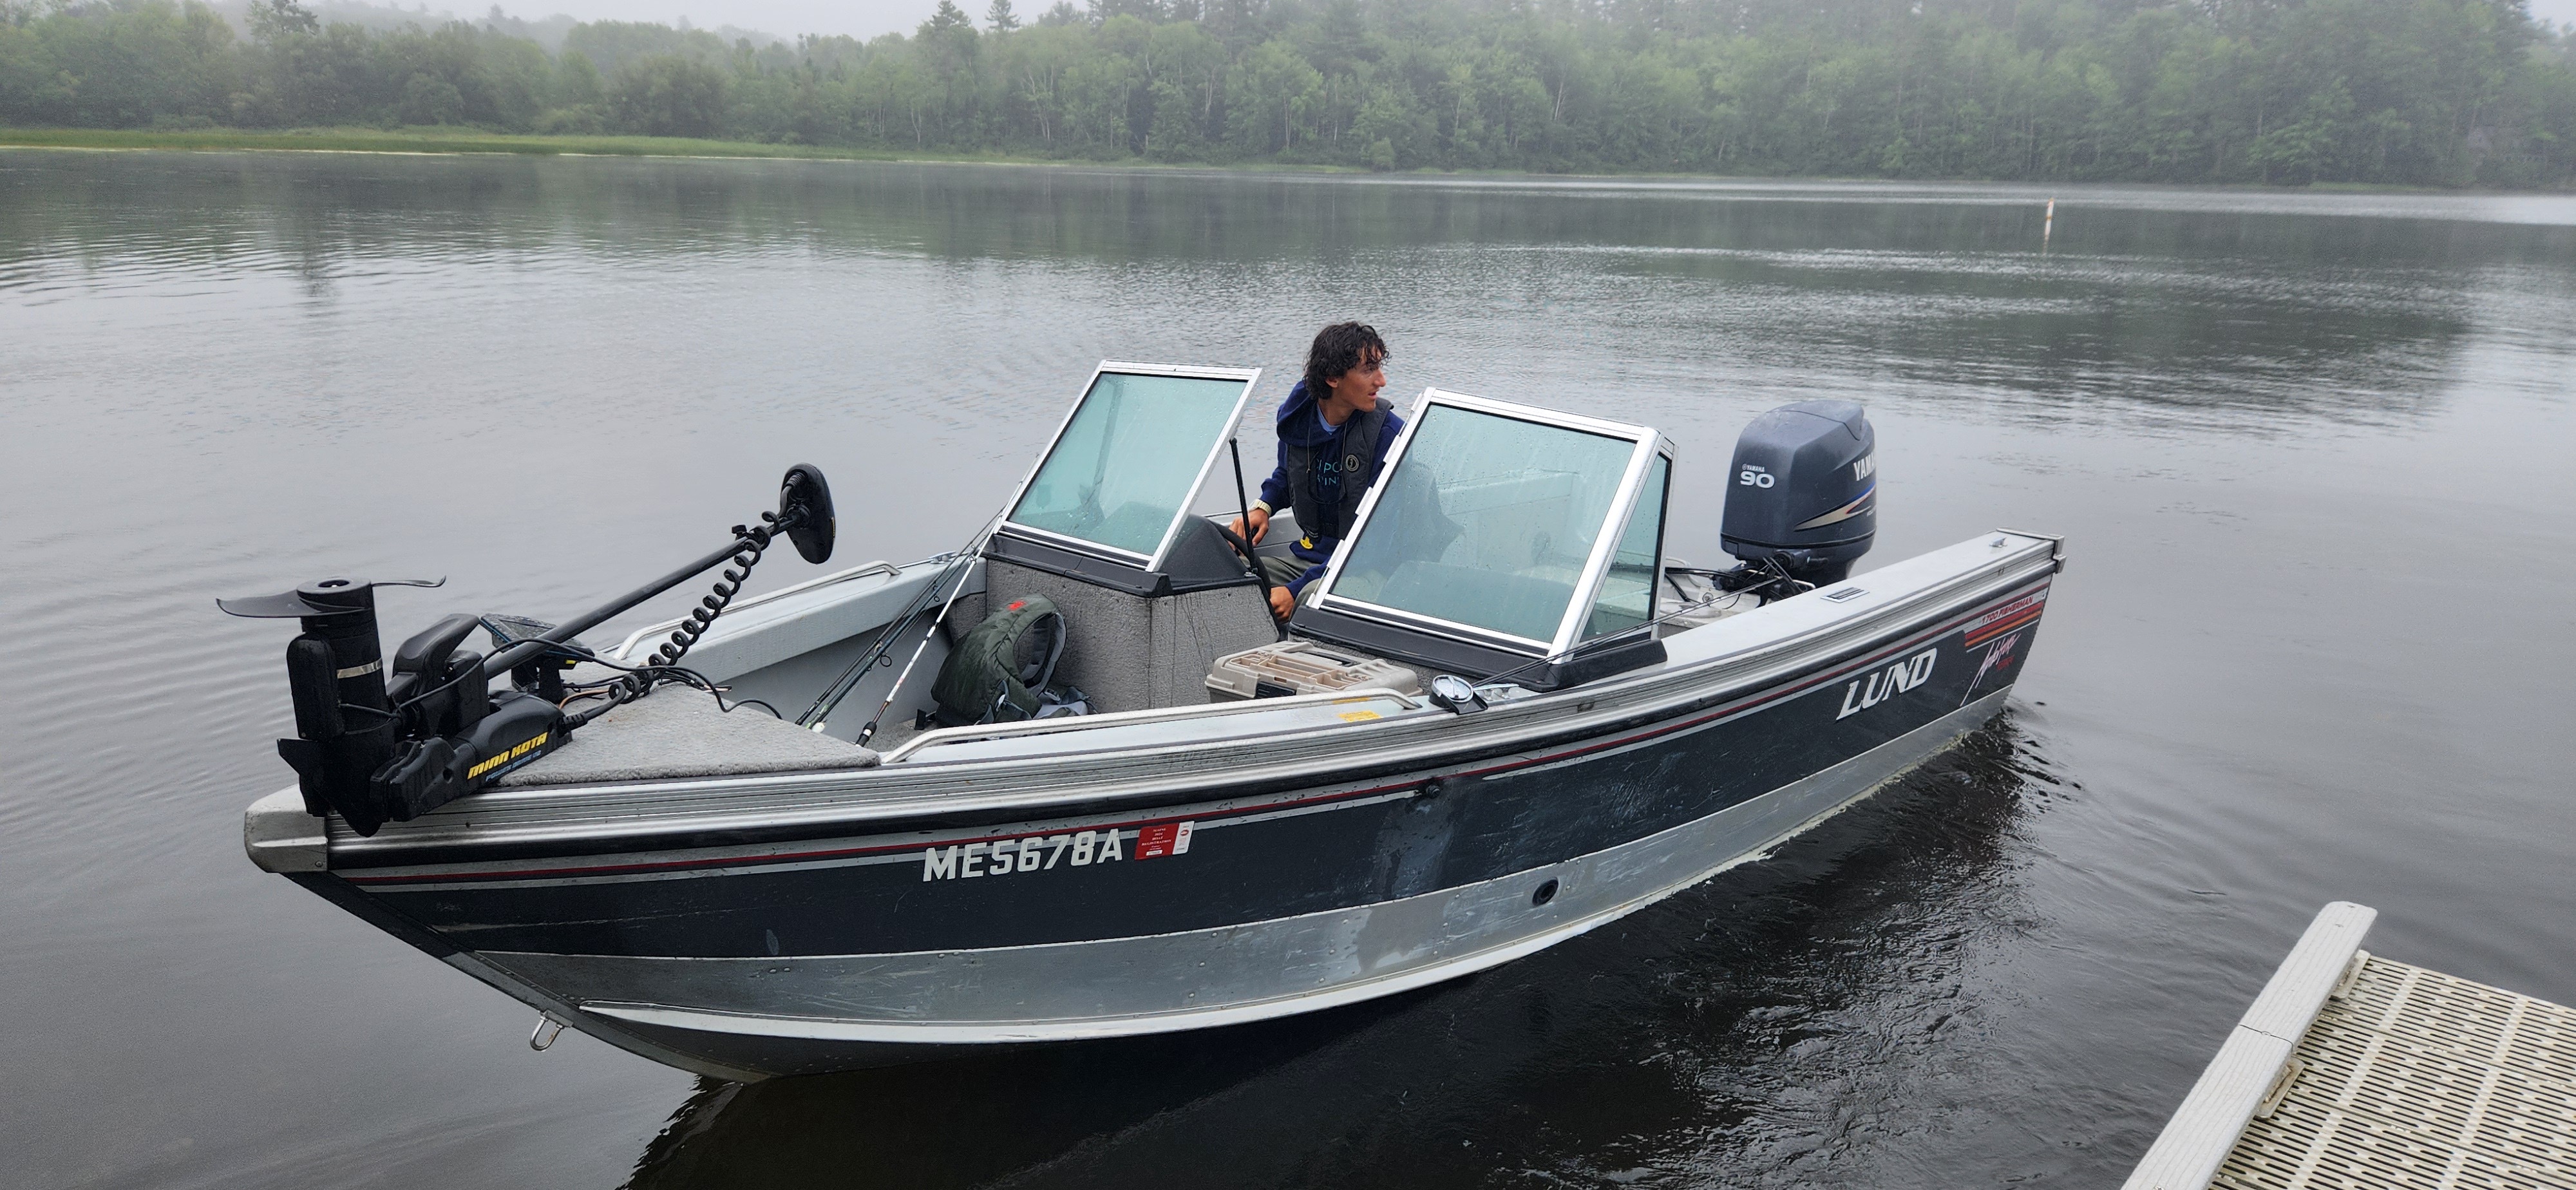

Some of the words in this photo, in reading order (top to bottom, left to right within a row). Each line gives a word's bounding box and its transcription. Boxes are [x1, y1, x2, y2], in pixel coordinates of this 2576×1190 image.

[1740, 471, 1775, 489] 90
[1747, 464, 1765, 473] YAMAHA
[1982, 611, 1999, 625] 1700
[1836, 647, 1938, 721] LUND
[468, 750, 510, 780] MINN
[511, 732, 548, 759] KOTA
[923, 828, 1122, 882] ME5678A
